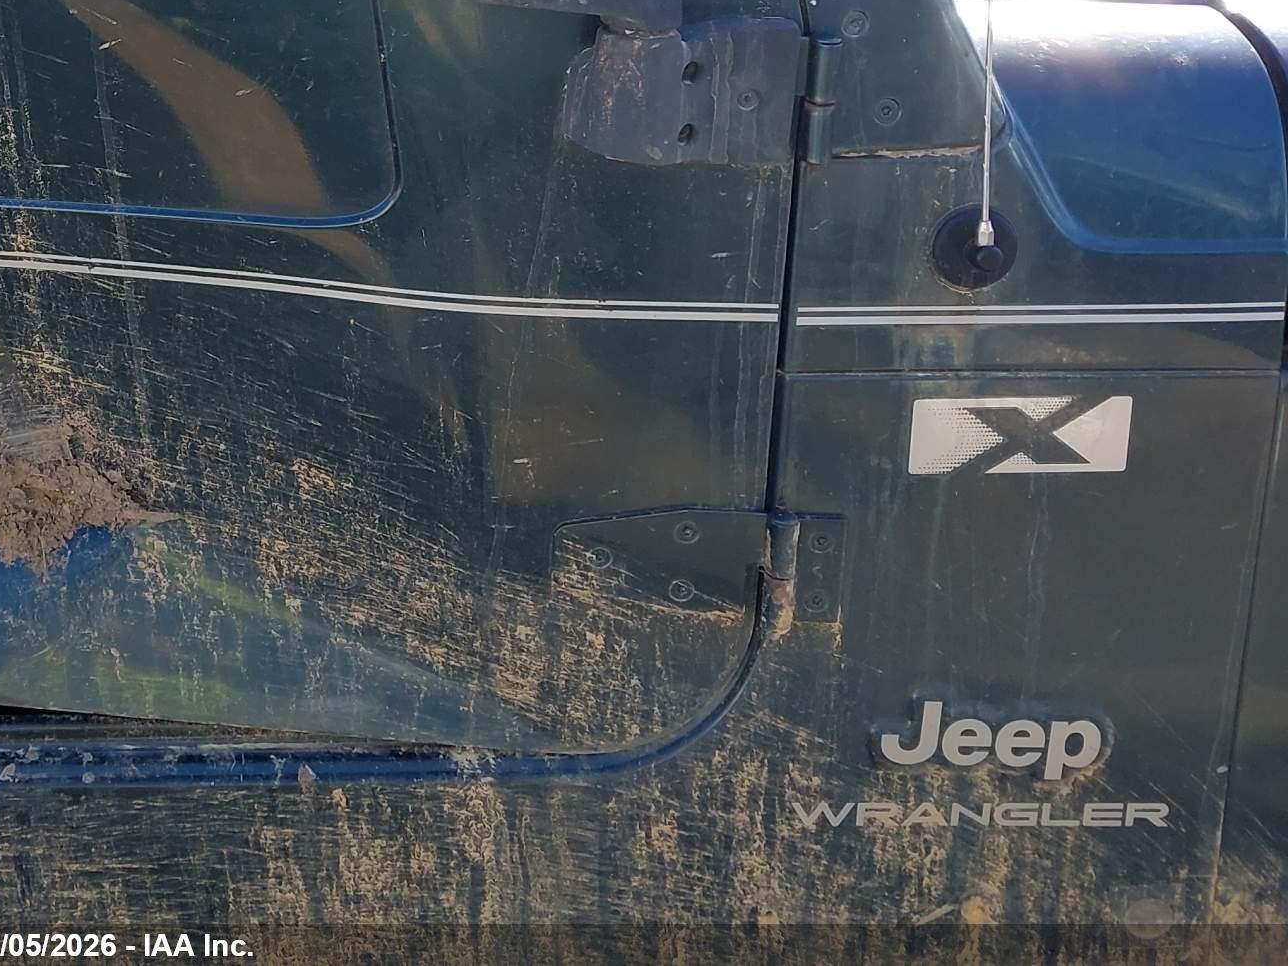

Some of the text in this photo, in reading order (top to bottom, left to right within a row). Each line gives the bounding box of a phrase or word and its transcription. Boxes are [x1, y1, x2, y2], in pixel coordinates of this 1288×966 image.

[945, 396, 1112, 474] X
[880, 700, 1102, 780] Jeep
[792, 802, 1170, 828] WRANGLER
